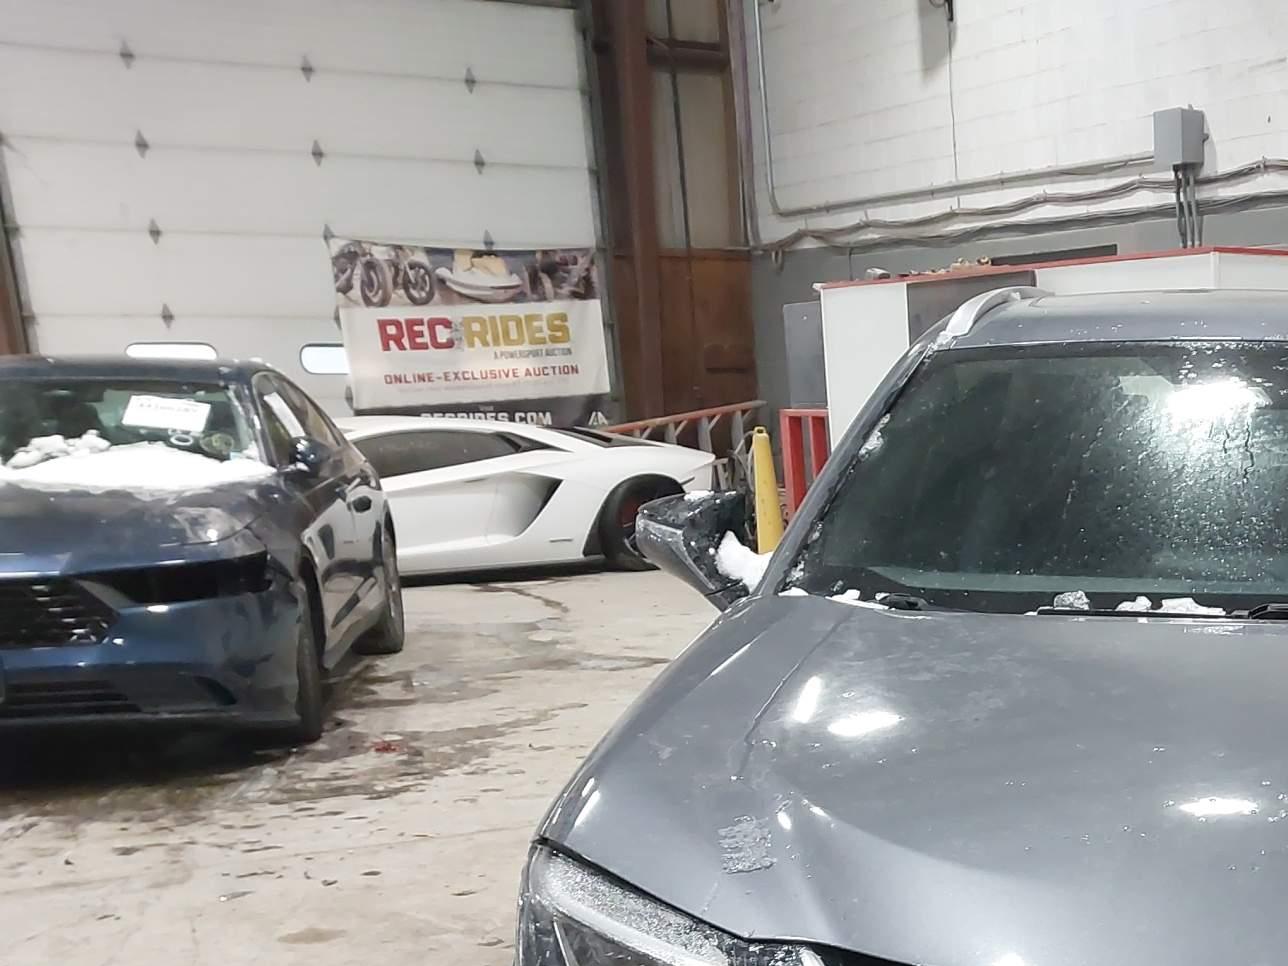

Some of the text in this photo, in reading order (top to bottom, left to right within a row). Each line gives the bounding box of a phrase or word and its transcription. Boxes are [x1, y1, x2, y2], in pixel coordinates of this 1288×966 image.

[377, 312, 571, 351] REC RIDES
[384, 367, 520, 385] ONLINE-EXCLUSIVE
[525, 364, 579, 377] AUCTION
